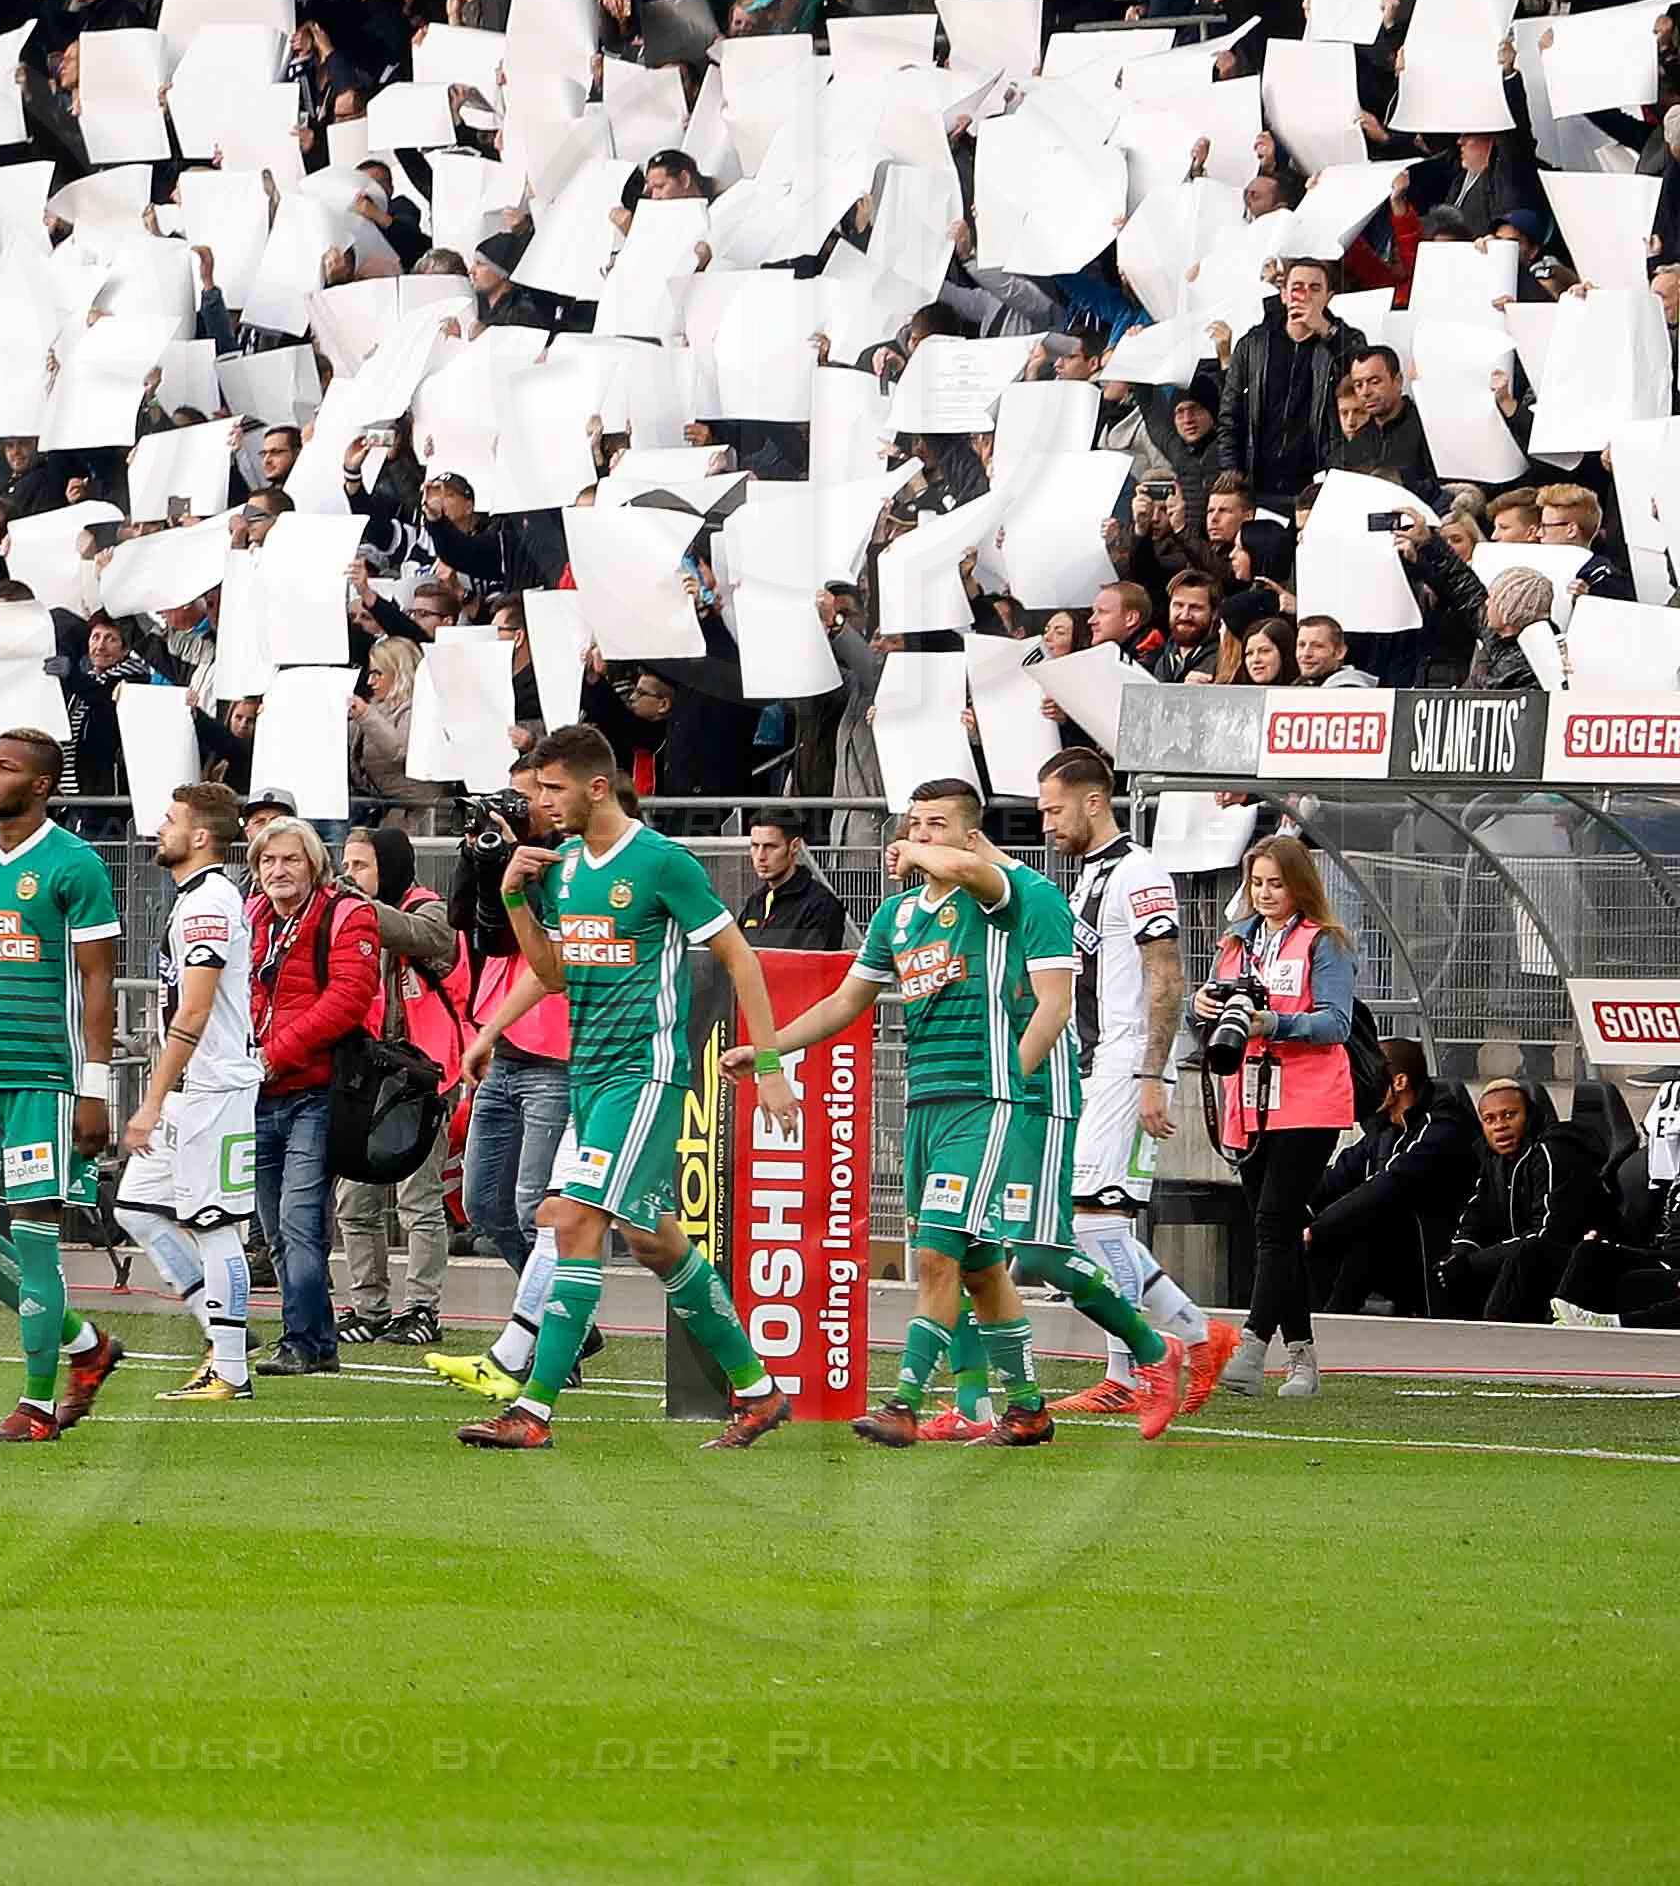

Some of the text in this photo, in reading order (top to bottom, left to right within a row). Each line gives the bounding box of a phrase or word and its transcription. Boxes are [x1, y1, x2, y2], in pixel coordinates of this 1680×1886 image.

[1272, 715, 1381, 751] SORGER
[562, 943, 631, 963] ERGIE
[902, 960, 962, 999] NERGE
[1599, 1005, 1680, 1039] SORG
[820, 1043, 856, 1249] Innovation
[6, 1161, 50, 1180] mplete
[925, 1191, 961, 1204] plete
